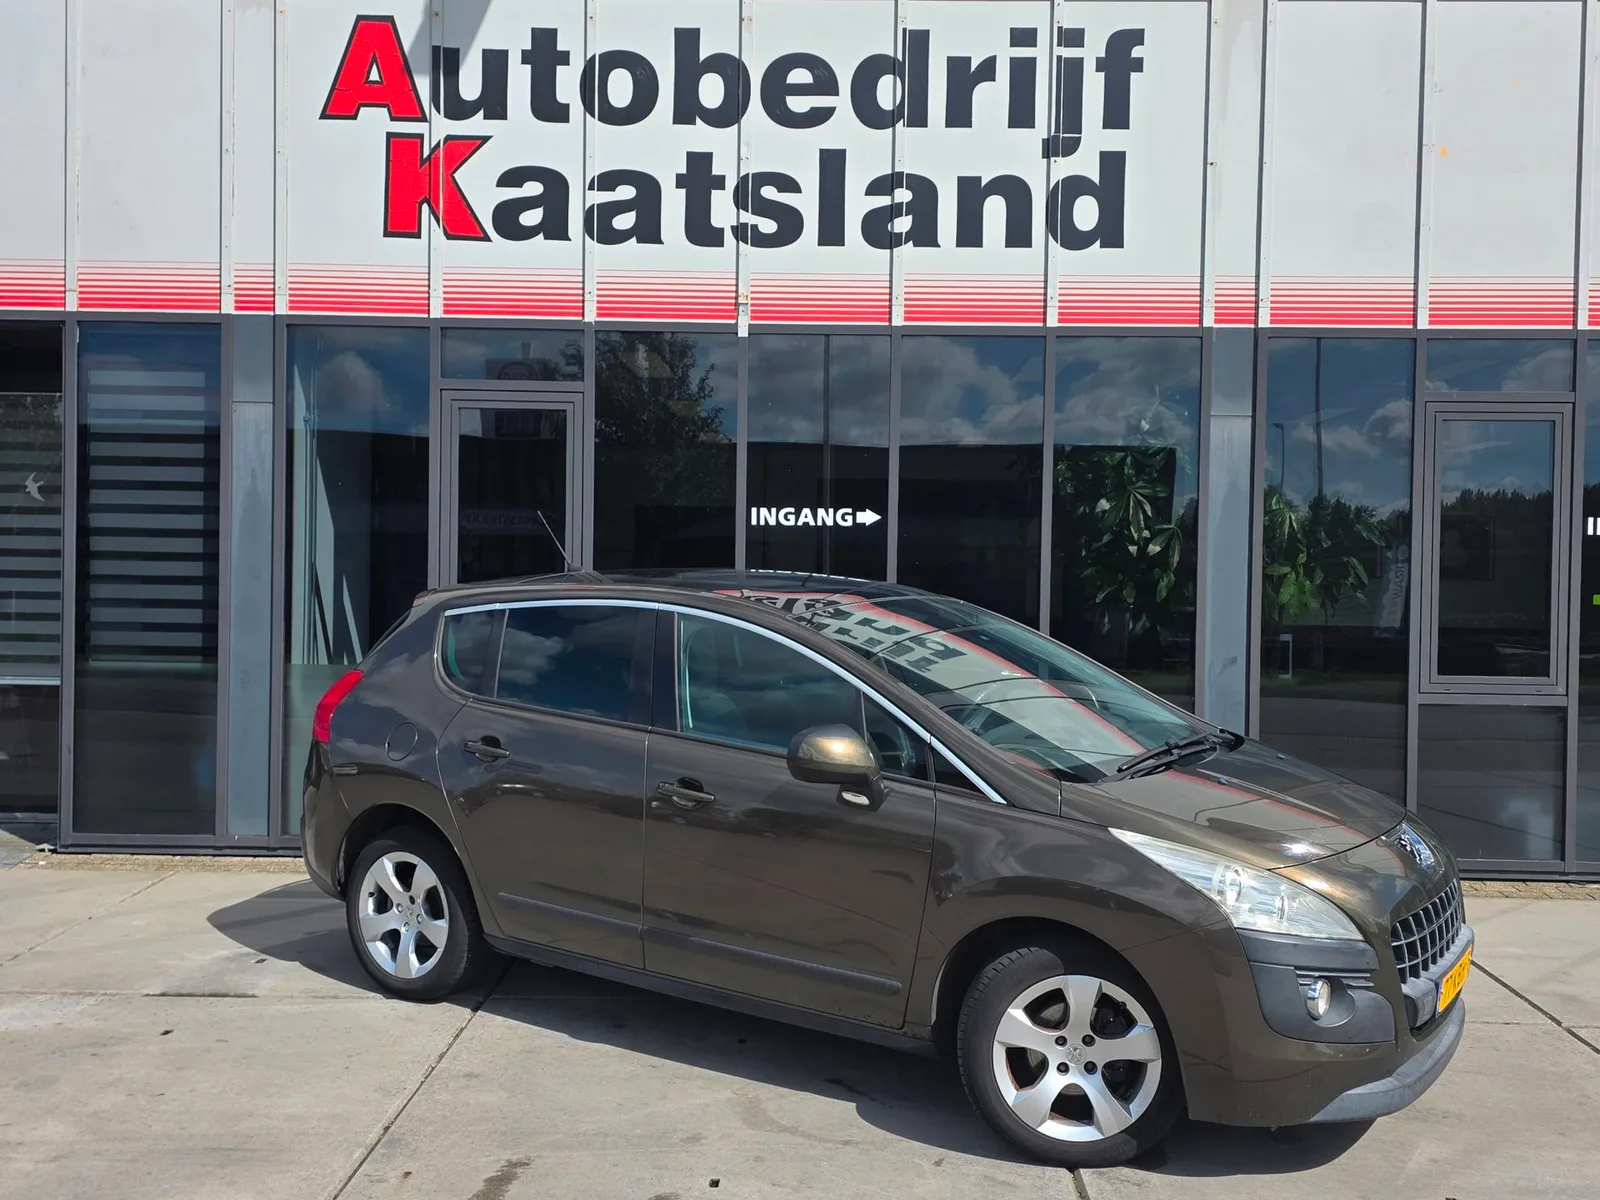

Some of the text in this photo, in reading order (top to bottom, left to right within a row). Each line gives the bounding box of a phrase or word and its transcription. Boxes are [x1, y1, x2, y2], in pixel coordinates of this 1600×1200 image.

[319, 14, 1145, 158] Autobedrijf
[383, 132, 1126, 251] Kaatsland
[750, 506, 853, 527] INGANG
